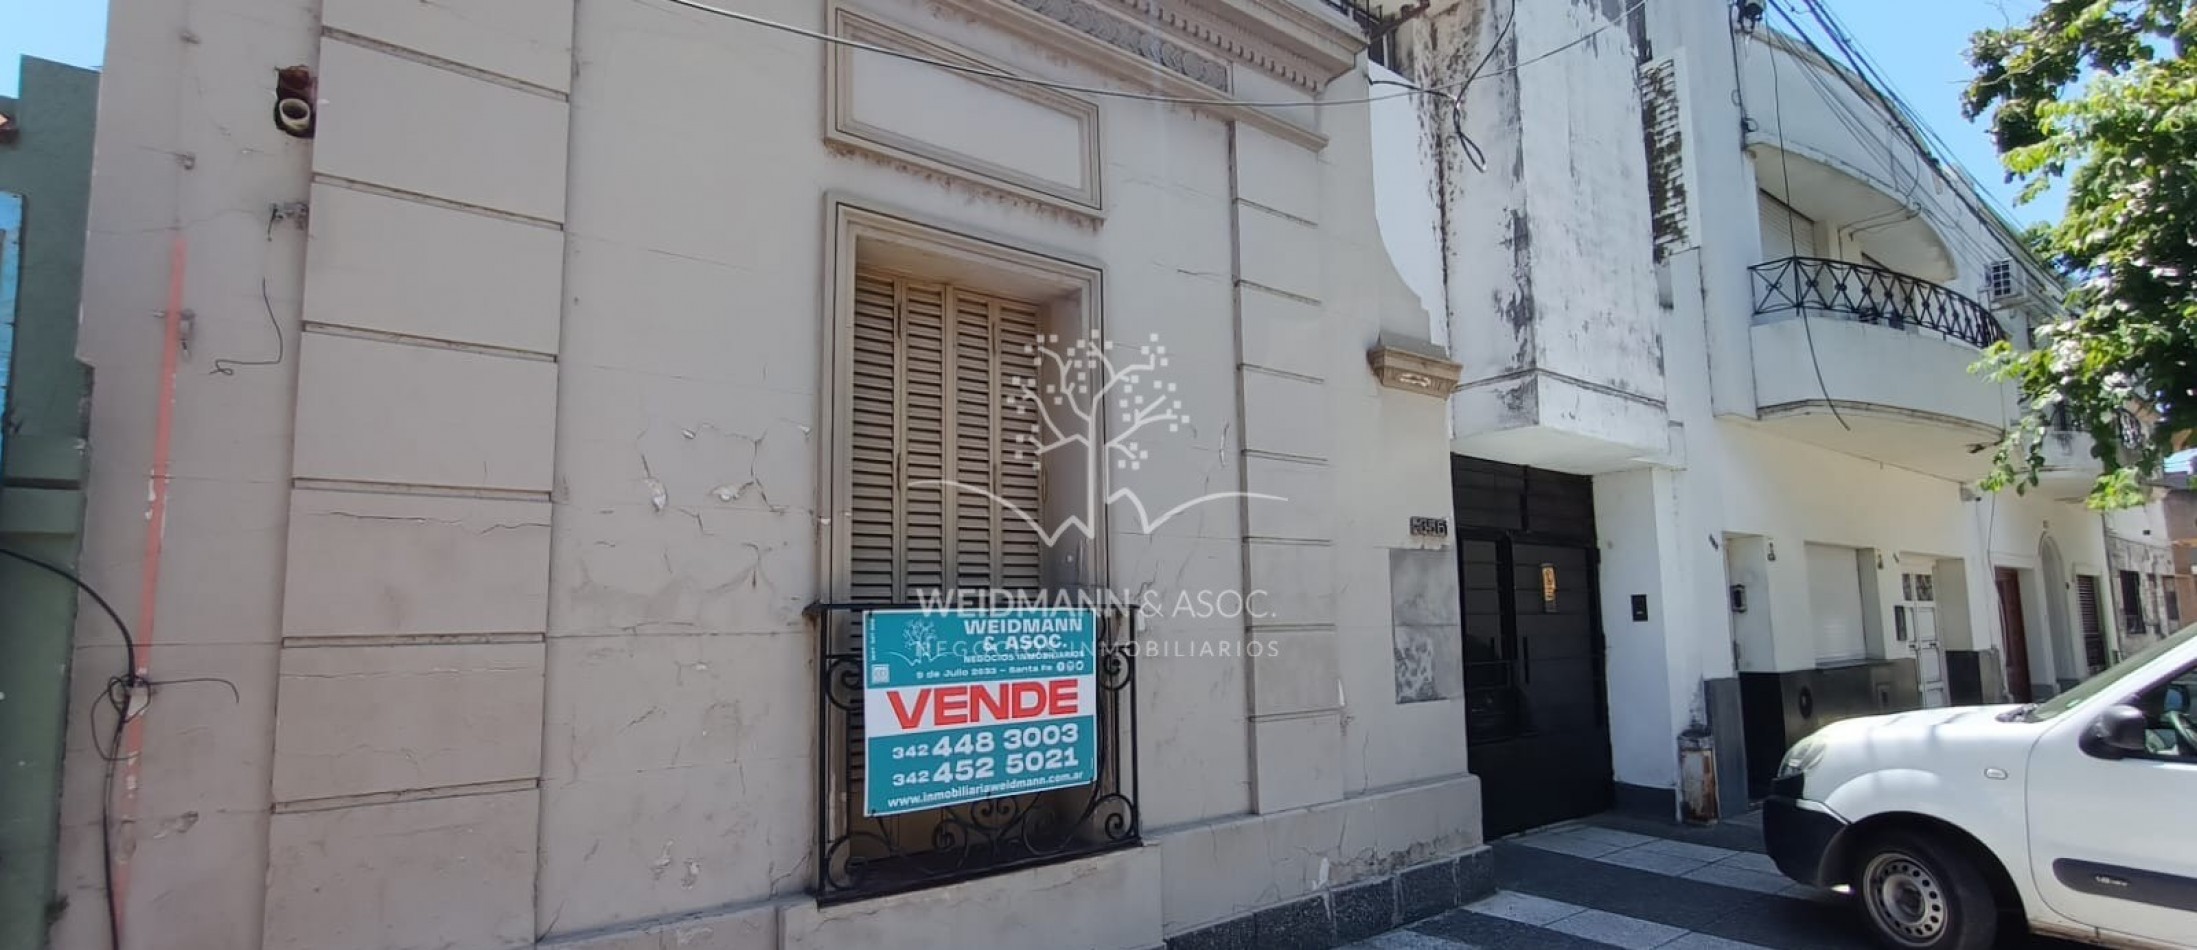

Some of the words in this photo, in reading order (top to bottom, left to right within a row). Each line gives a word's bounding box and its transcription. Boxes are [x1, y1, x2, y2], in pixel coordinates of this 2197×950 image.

[963, 618, 1083, 635] WEIDMANN
[982, 636, 996, 651] &
[1004, 634, 1068, 650] ASOC.
[963, 653, 1014, 664] NEGOCIOS
[1016, 649, 1085, 662] INMOBILIARIOS
[943, 667, 969, 678] Julio
[1008, 665, 1039, 675] Santa
[887, 678, 1079, 730] VENDE
[892, 744, 930, 759] 342
[932, 731, 995, 757] 448
[1003, 723, 1079, 750] 3003
[893, 770, 930, 786] 342
[933, 757, 995, 783] 452
[1005, 747, 1079, 774] 5021
[887, 771, 1083, 808] www.inmobiliariaweidmann.com.ar
